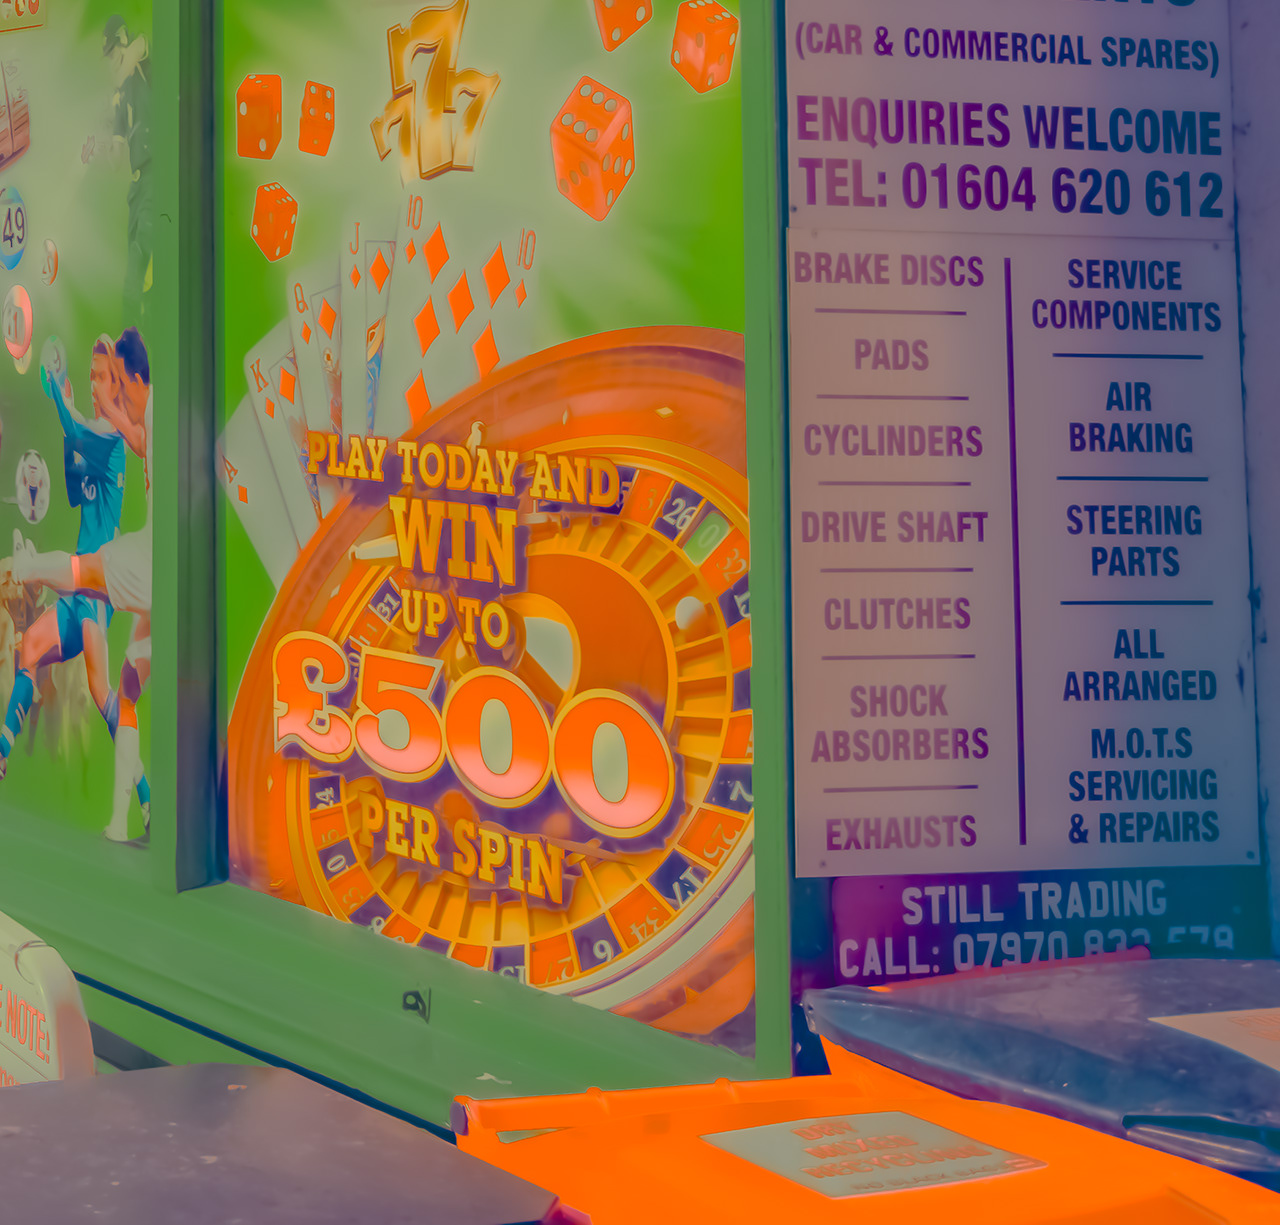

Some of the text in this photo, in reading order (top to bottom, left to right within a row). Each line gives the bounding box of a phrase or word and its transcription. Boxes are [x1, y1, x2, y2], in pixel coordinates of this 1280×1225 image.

[795, 21, 1220, 78] (CAR & COMMERCIAL SPARES)
[796, 95, 1222, 155] ENQUIRIES WELCOME
[798, 157, 1224, 218] TEL: 01604 620 612
[3, 207, 25, 247] 49
[794, 251, 985, 288] BRAKE DISCS
[1067, 258, 1183, 291] SERVICE
[1031, 299, 1222, 332] COMPONENTS
[854, 338, 929, 372] PADS
[1105, 381, 1152, 412] AIR
[803, 424, 983, 458] CYCLINDERS
[1069, 422, 1194, 454] BRAKING
[306, 430, 622, 509] PLAY TODAY AND
[801, 511, 989, 544] DRIVE SHAFT
[1066, 504, 1203, 536] STEERING
[388, 495, 519, 587] WIN
[1091, 546, 1180, 578] PARTS
[400, 587, 510, 649] UP TO
[824, 597, 971, 630] CLUTCHES
[1113, 628, 1165, 660] ALL
[849, 684, 949, 718] SHOCK
[1063, 670, 1218, 702] ARRANGED
[272, 630, 676, 840] £500
[811, 727, 990, 763] ABSORBERS
[1091, 727, 1193, 759] M.O.T.S
[1068, 768, 1218, 801] SERVICING
[826, 815, 978, 852] EXHAUSTS
[1068, 810, 1221, 845] & REPAIRS
[358, 788, 567, 905] PER SPIN
[901, 879, 1168, 926] STILL TRADING
[839, 934, 940, 978] CALL:
[953, 930, 1069, 973] 07970
[791, 1122, 859, 1140] DRY
[803, 1135, 918, 1160] MIXED
[800, 1145, 992, 1179] RECYCLING
